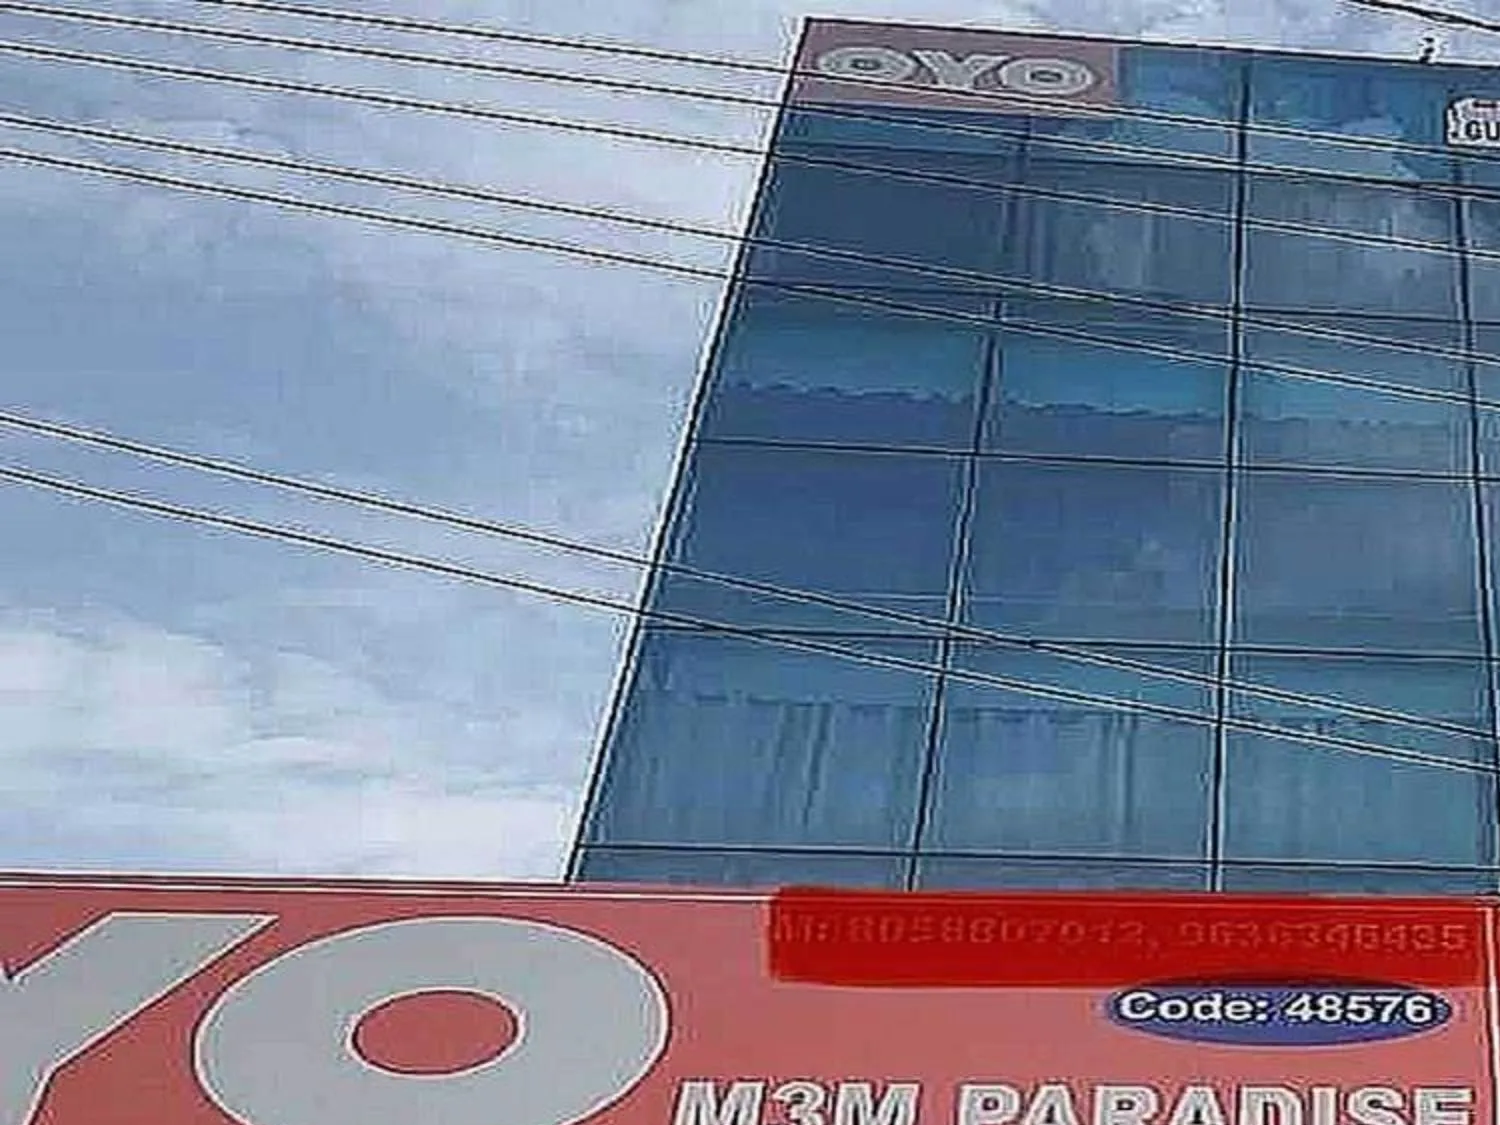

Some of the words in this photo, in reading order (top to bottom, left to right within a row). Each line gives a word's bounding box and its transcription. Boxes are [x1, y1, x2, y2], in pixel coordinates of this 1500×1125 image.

[817, 46, 1096, 97] OYO
[1119, 991, 1269, 1022] Code:
[1284, 993, 1433, 1024] 48576
